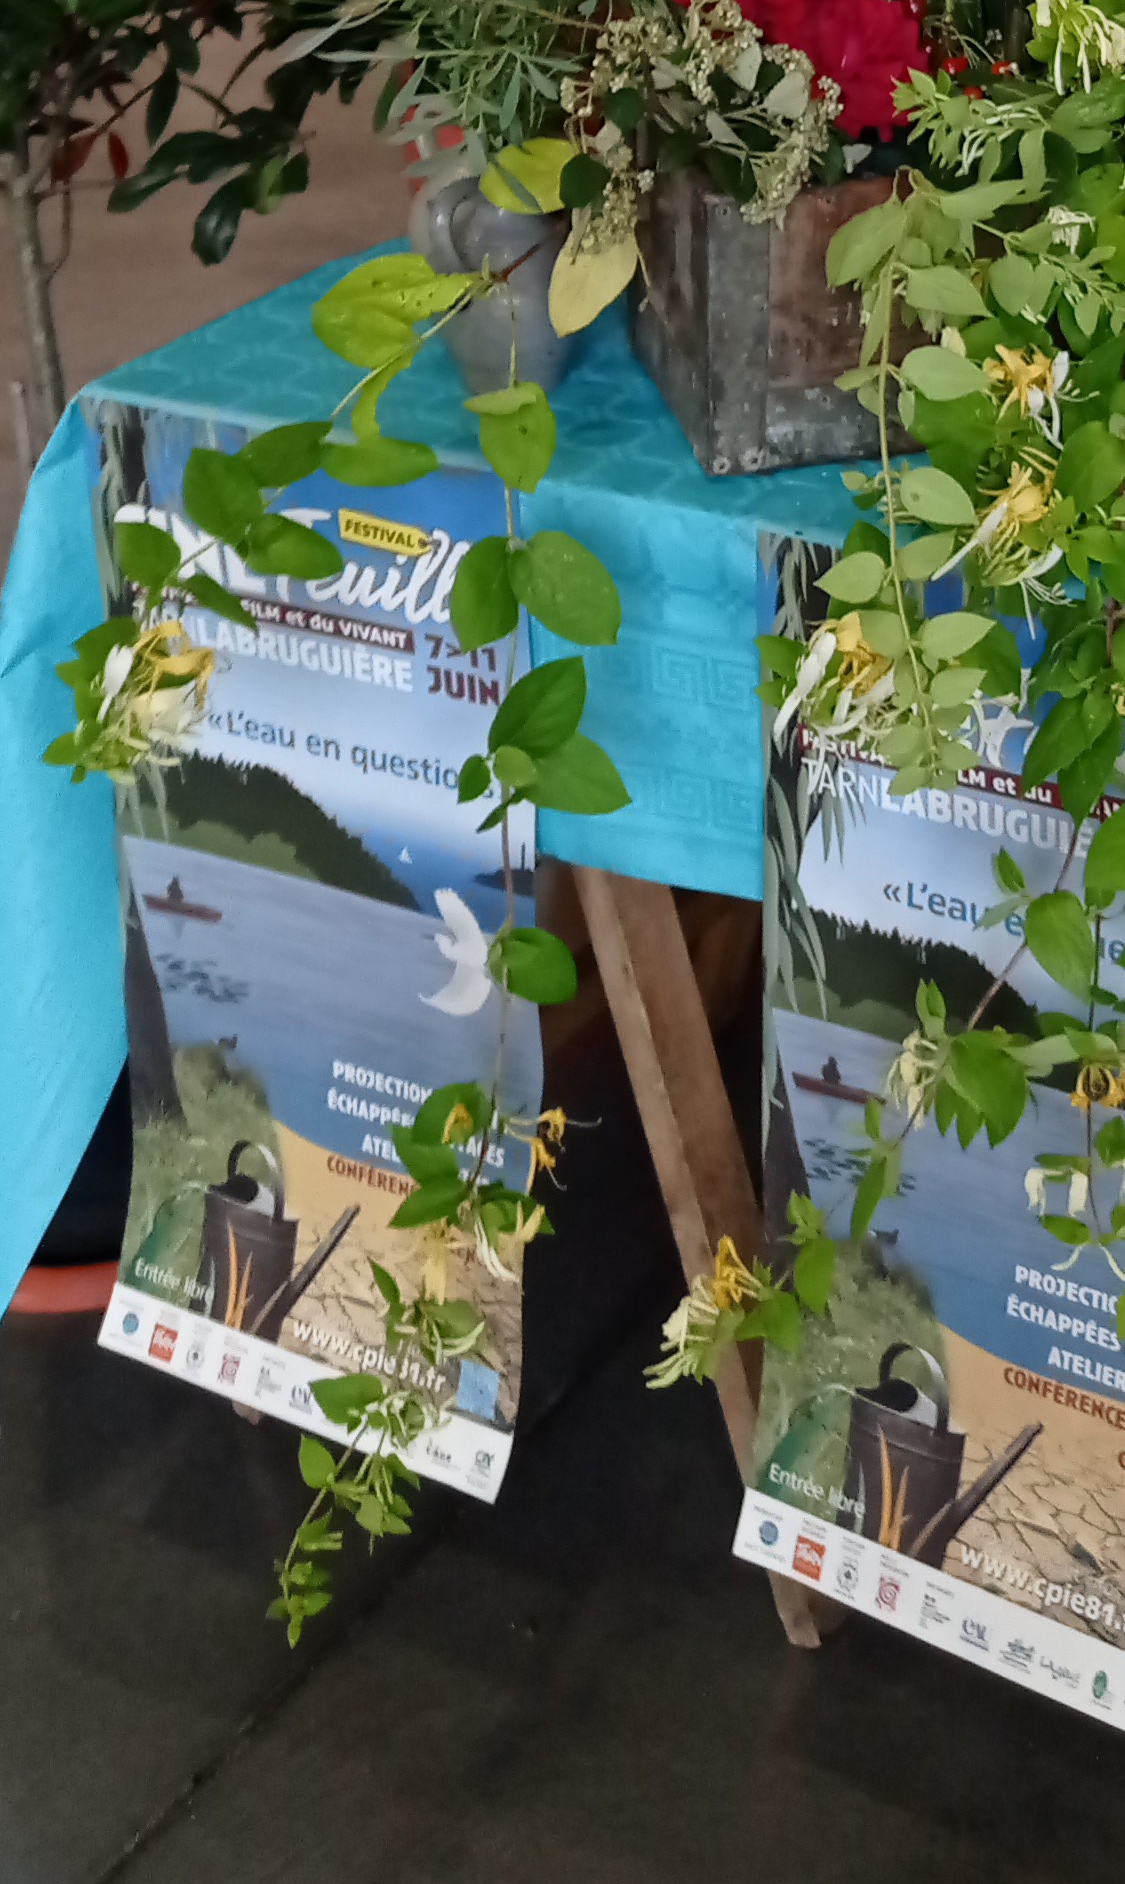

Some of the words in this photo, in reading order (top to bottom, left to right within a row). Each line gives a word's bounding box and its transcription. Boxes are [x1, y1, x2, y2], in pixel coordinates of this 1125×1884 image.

[343, 518, 415, 550] FESTIVAL
[285, 609, 307, 628] et
[310, 614, 334, 634] du
[338, 621, 407, 649] VIVANT
[426, 666, 500, 707] JUIN
[306, 733, 341, 761] en
[992, 776, 1017, 796] et
[135, 1258, 181, 1292] Entrée
[1007, 1293, 1122, 1352] ÉCHAPPÉES
[768, 1462, 825, 1501] Entrée
[829, 1486, 866, 1519] libre
